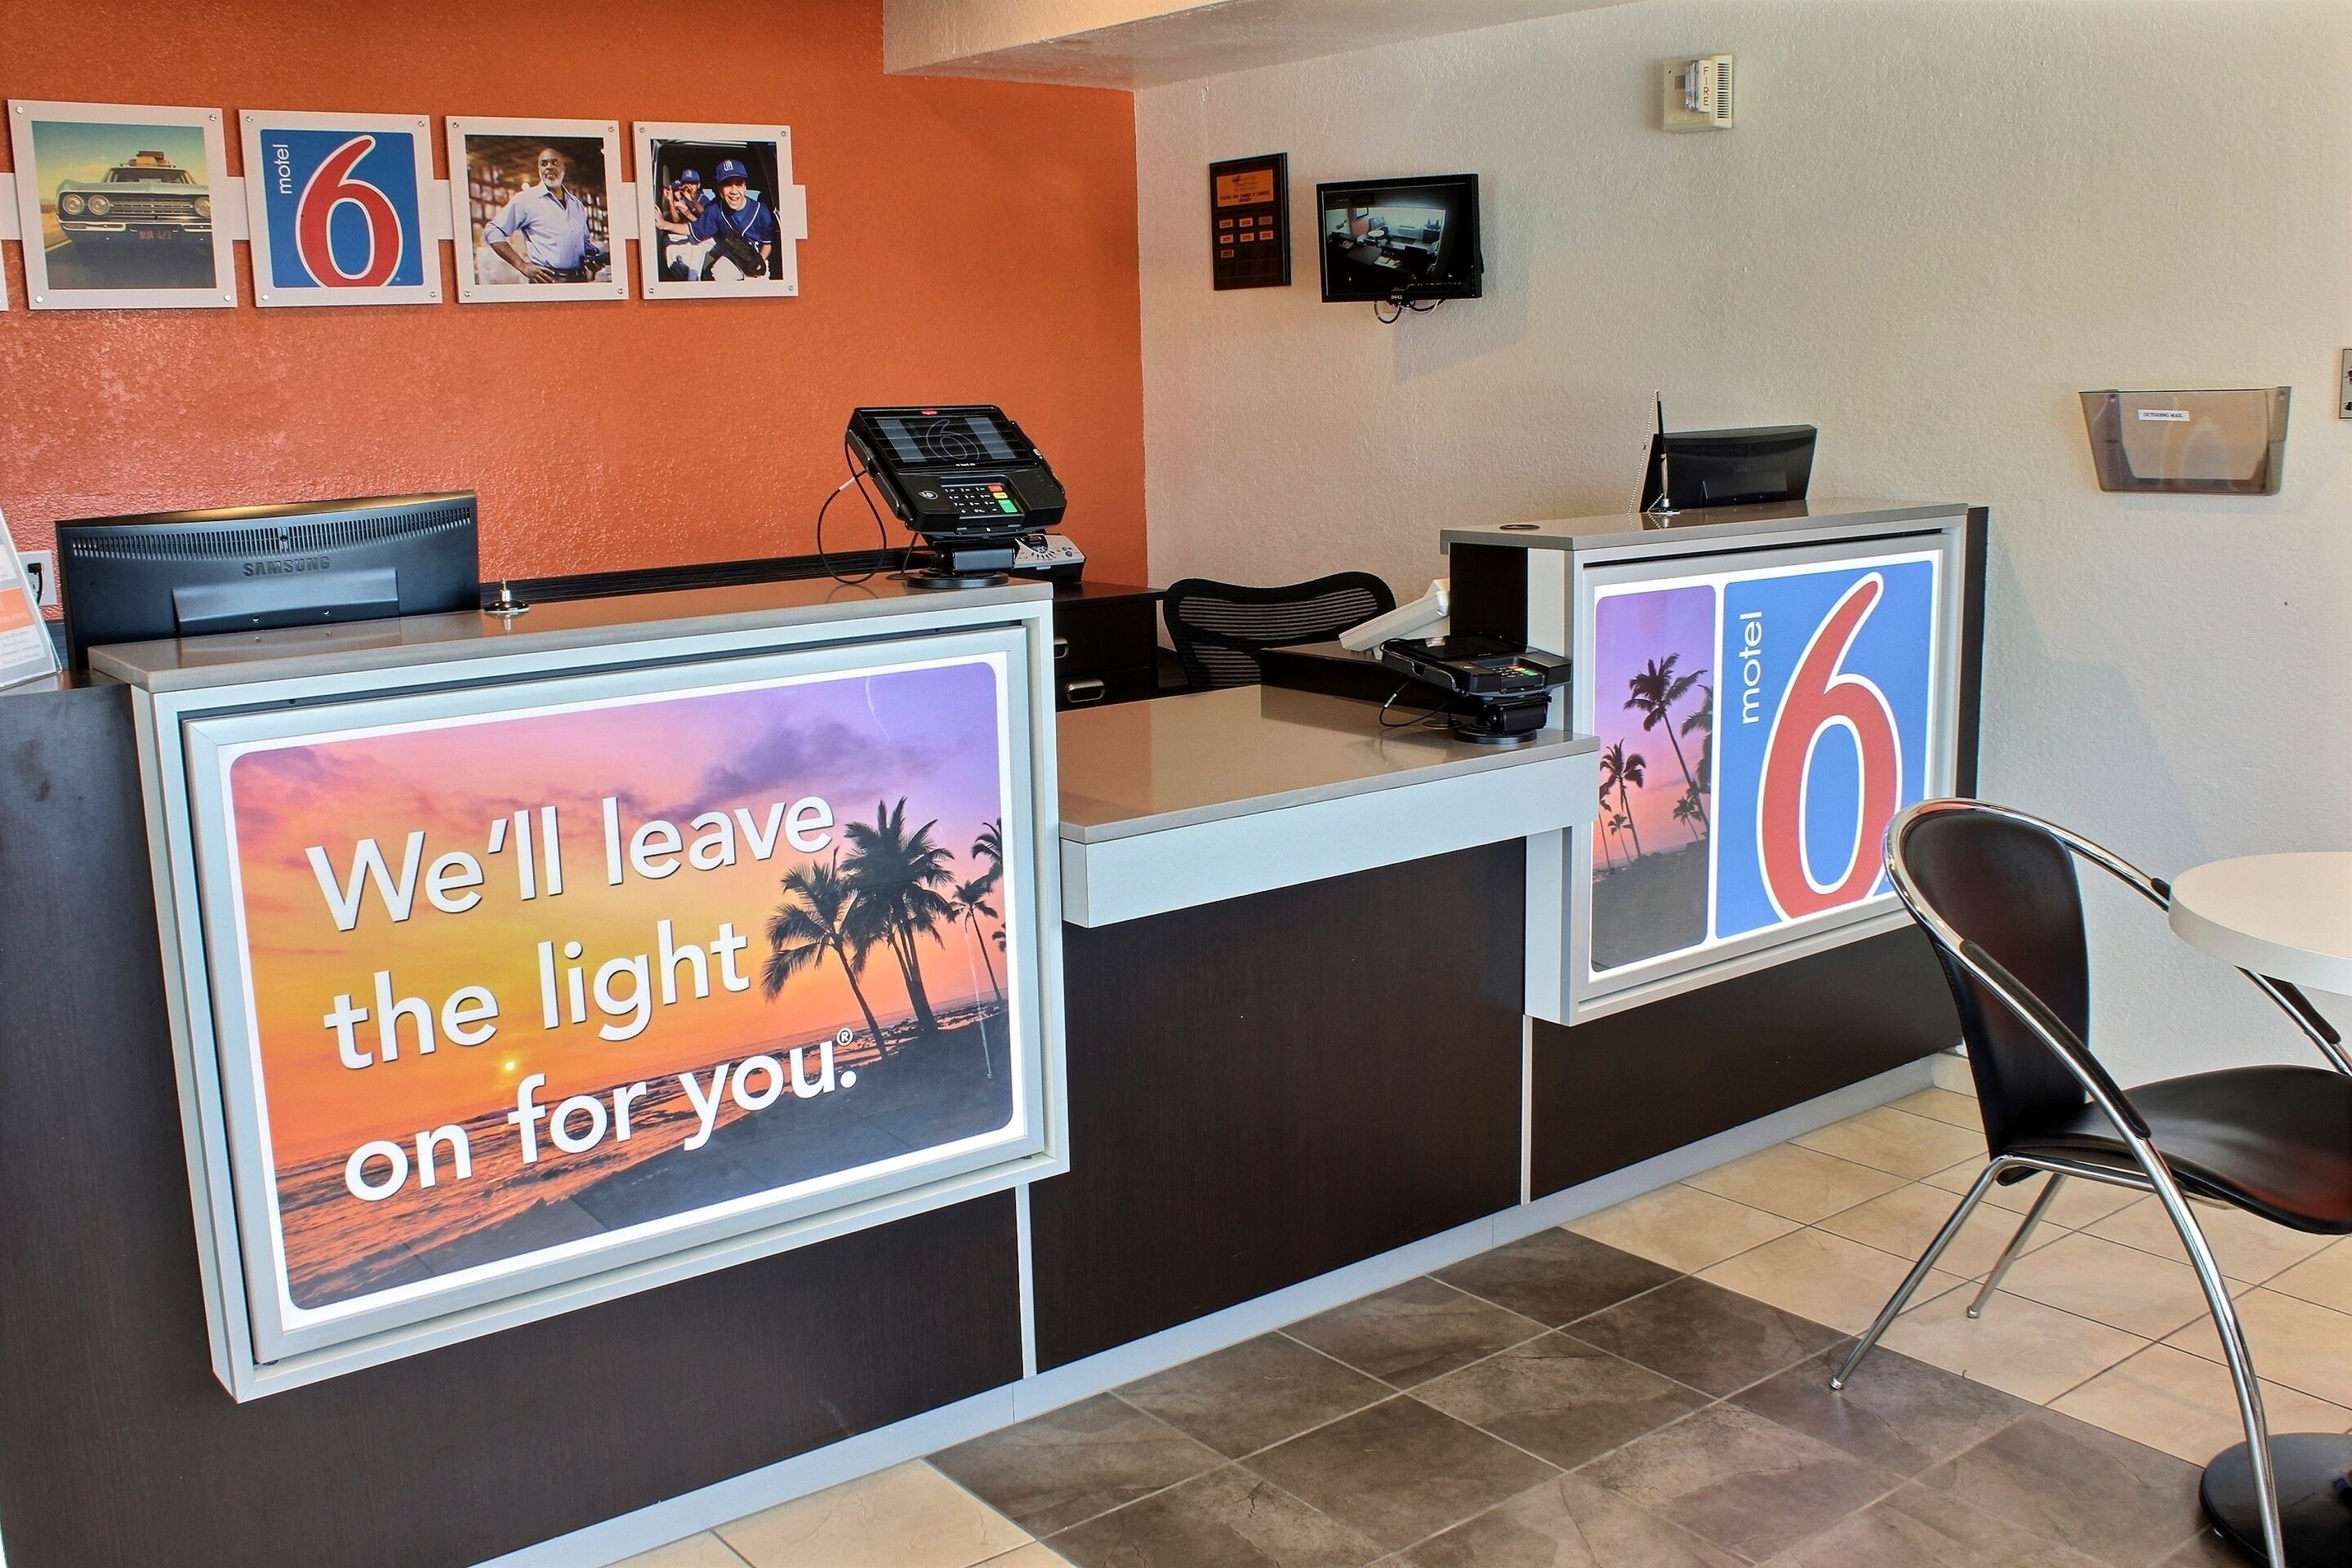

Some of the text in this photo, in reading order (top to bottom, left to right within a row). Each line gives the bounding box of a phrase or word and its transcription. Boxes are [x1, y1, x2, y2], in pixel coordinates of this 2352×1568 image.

[272, 134, 403, 288] motel 6
[243, 556, 330, 577] SAMSUNG
[1739, 572, 1903, 923] motel 6
[305, 795, 835, 931] We'll leave
[323, 919, 751, 1070] the light
[345, 1120, 473, 1201] on
[507, 1073, 648, 1165] for
